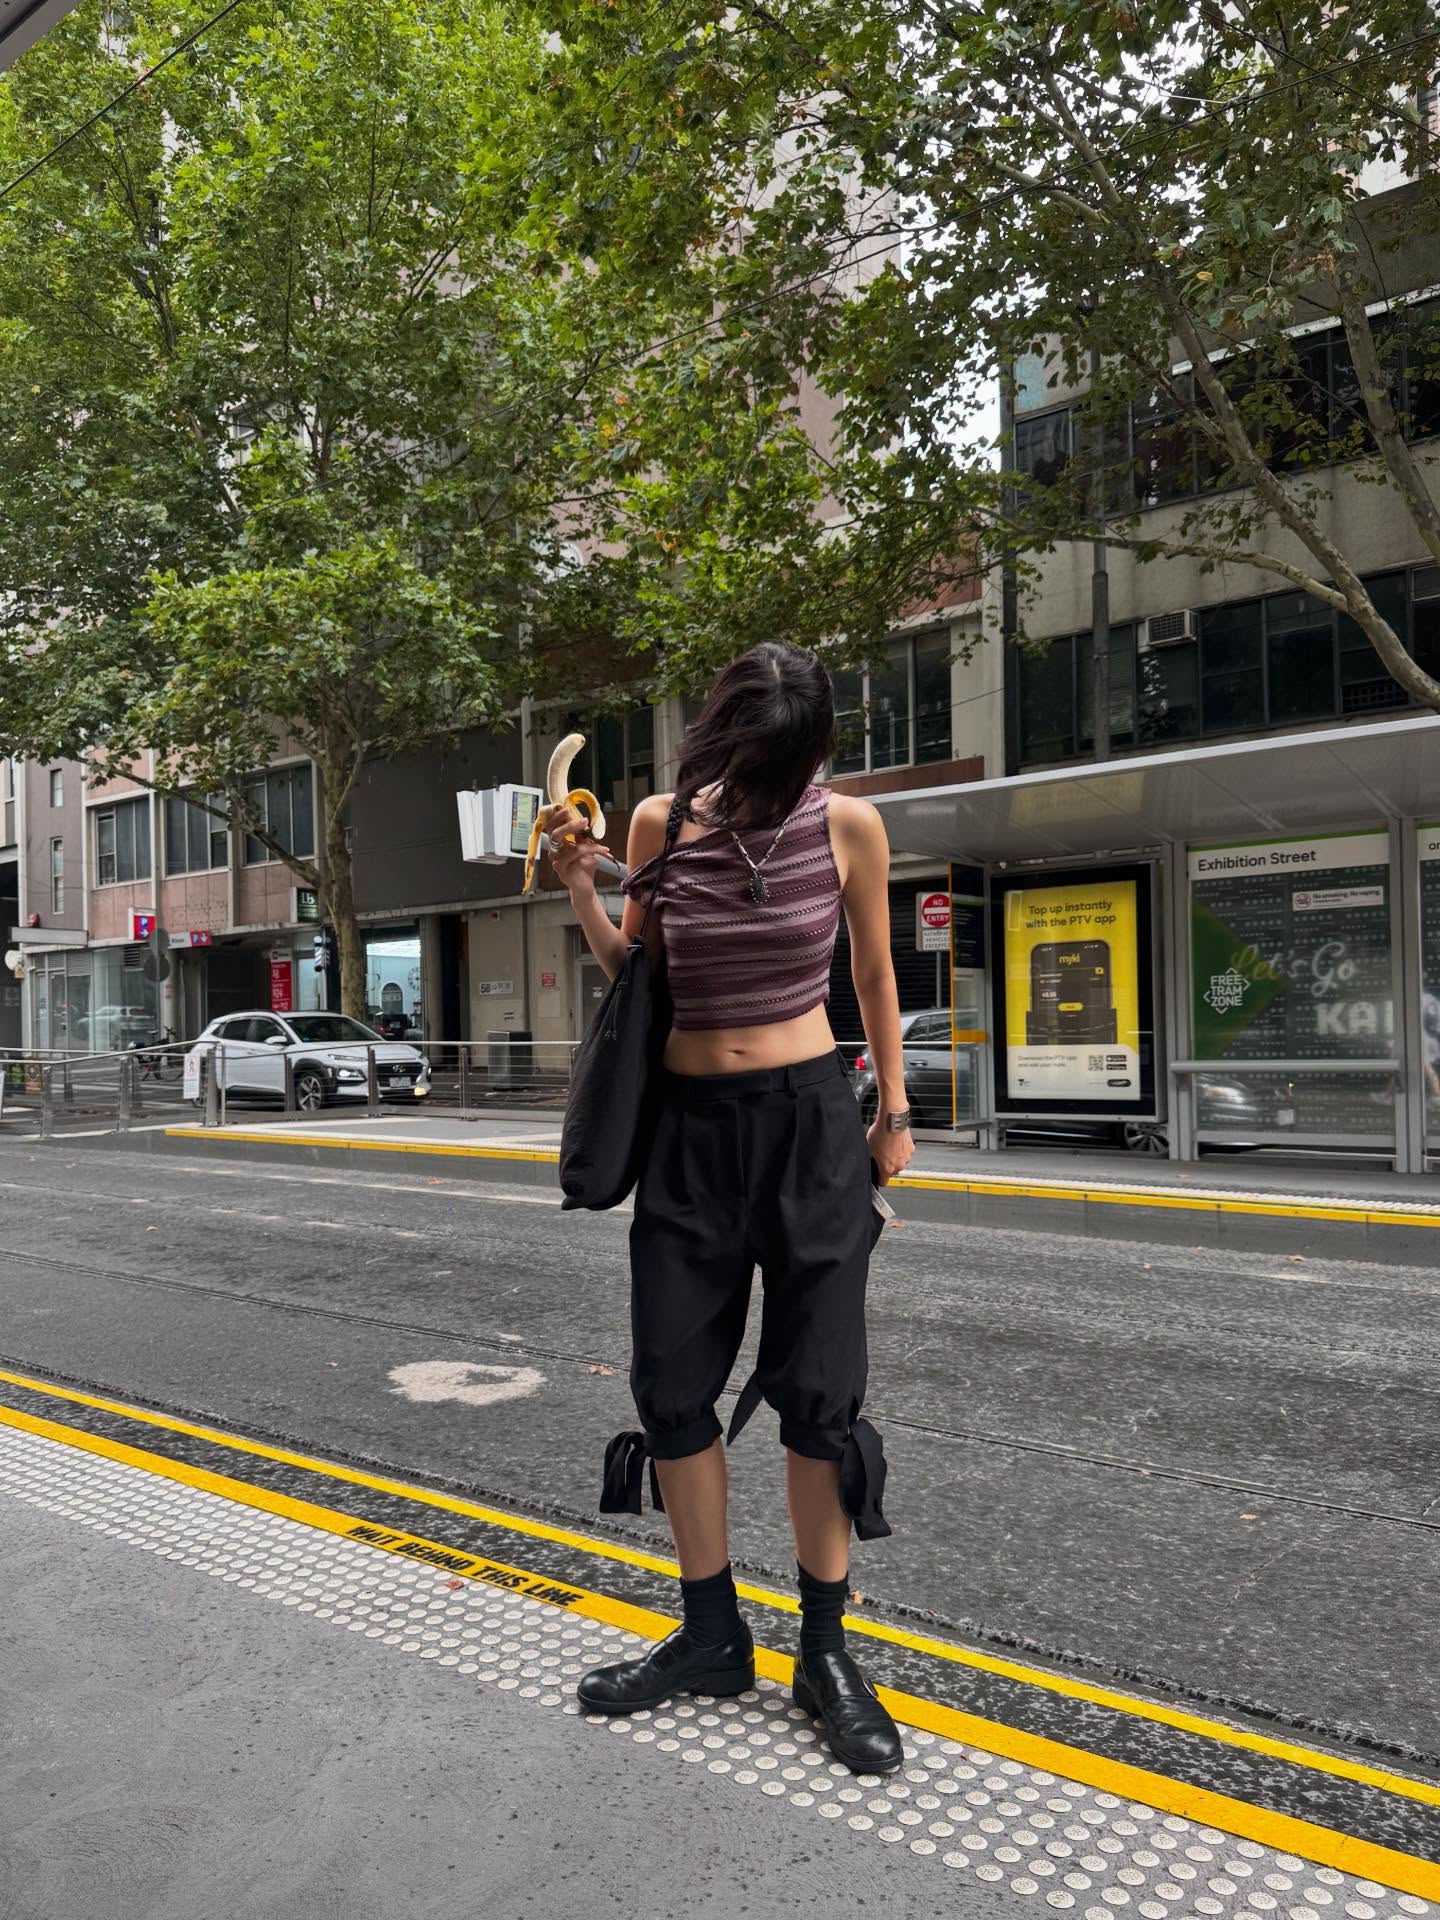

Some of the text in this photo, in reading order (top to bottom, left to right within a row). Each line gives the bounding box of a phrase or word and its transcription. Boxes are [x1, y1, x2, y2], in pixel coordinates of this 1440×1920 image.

[1198, 850, 1317, 872] Exhibition Street
[1028, 900, 1113, 916] Top up instantly
[141, 917, 149, 928] P
[926, 914, 949, 922] ENTRY
[1025, 914, 1117, 929] with the PTV app
[1059, 953, 1080, 966] myki
[1231, 941, 1356, 996] Let's Go
[1210, 975, 1243, 986] FREE
[481, 983, 491, 993] 58
[1210, 986, 1243, 996] TRAM
[1210, 996, 1243, 1007] ZONE
[346, 1525, 585, 1608] WAIT BEHIND THIS LINE
